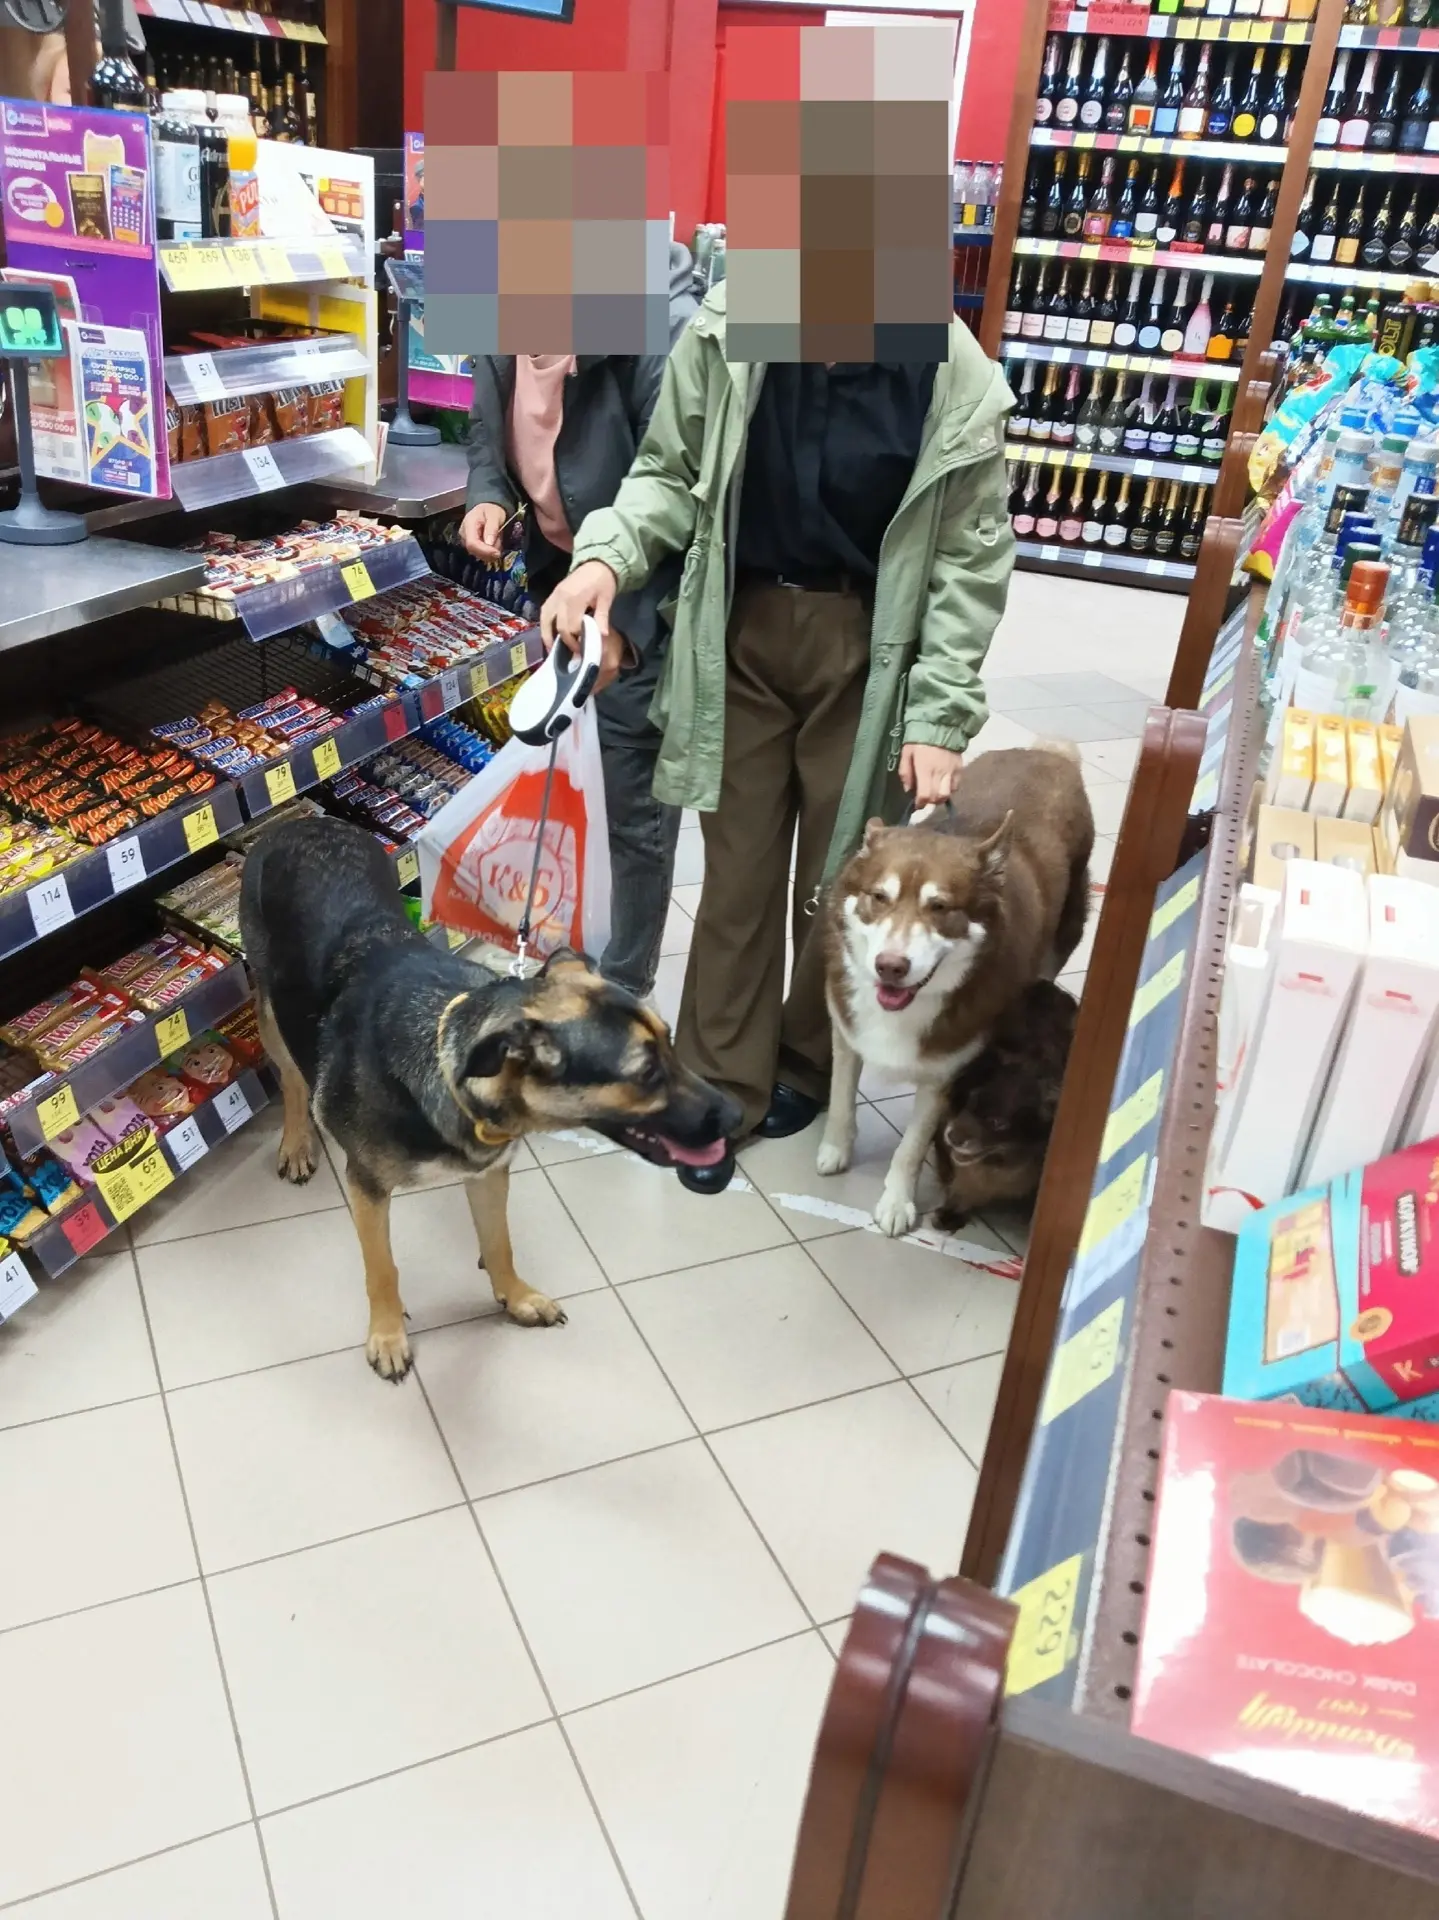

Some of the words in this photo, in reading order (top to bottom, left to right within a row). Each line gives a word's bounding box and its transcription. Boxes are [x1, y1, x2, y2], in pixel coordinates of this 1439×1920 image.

[168, 251, 187, 264] 469
[201, 250, 219, 263] 269
[1378, 318, 1402, 356] OLT
[199, 362, 212, 376] 51
[252, 455, 271, 469] 134
[322, 744, 333, 755] 74
[275, 766, 286, 778] 79
[196, 809, 209, 822] 74
[121, 848, 136, 863] 59
[41, 887, 61, 906] 114
[100, 952, 143, 979] TWIX
[124, 963, 167, 993] TWIX
[149, 976, 191, 1003] TWIX
[7, 1001, 57, 1032] TWIX
[168, 1014, 181, 1029] 74
[36, 1017, 87, 1046] TWIX
[60, 1033, 109, 1061] TWIX
[51, 1092, 66, 1110] 99
[229, 1092, 241, 1106] 41
[96, 1145, 124, 1172] ЦЕНА
[123, 1128, 149, 1154] ДНЯ!
[142, 1157, 157, 1174] 69
[5, 1264, 20, 1284] 41
[1034, 1577, 1071, 1657] 229
[1235, 1653, 1357, 1686] CHOCOLATE
